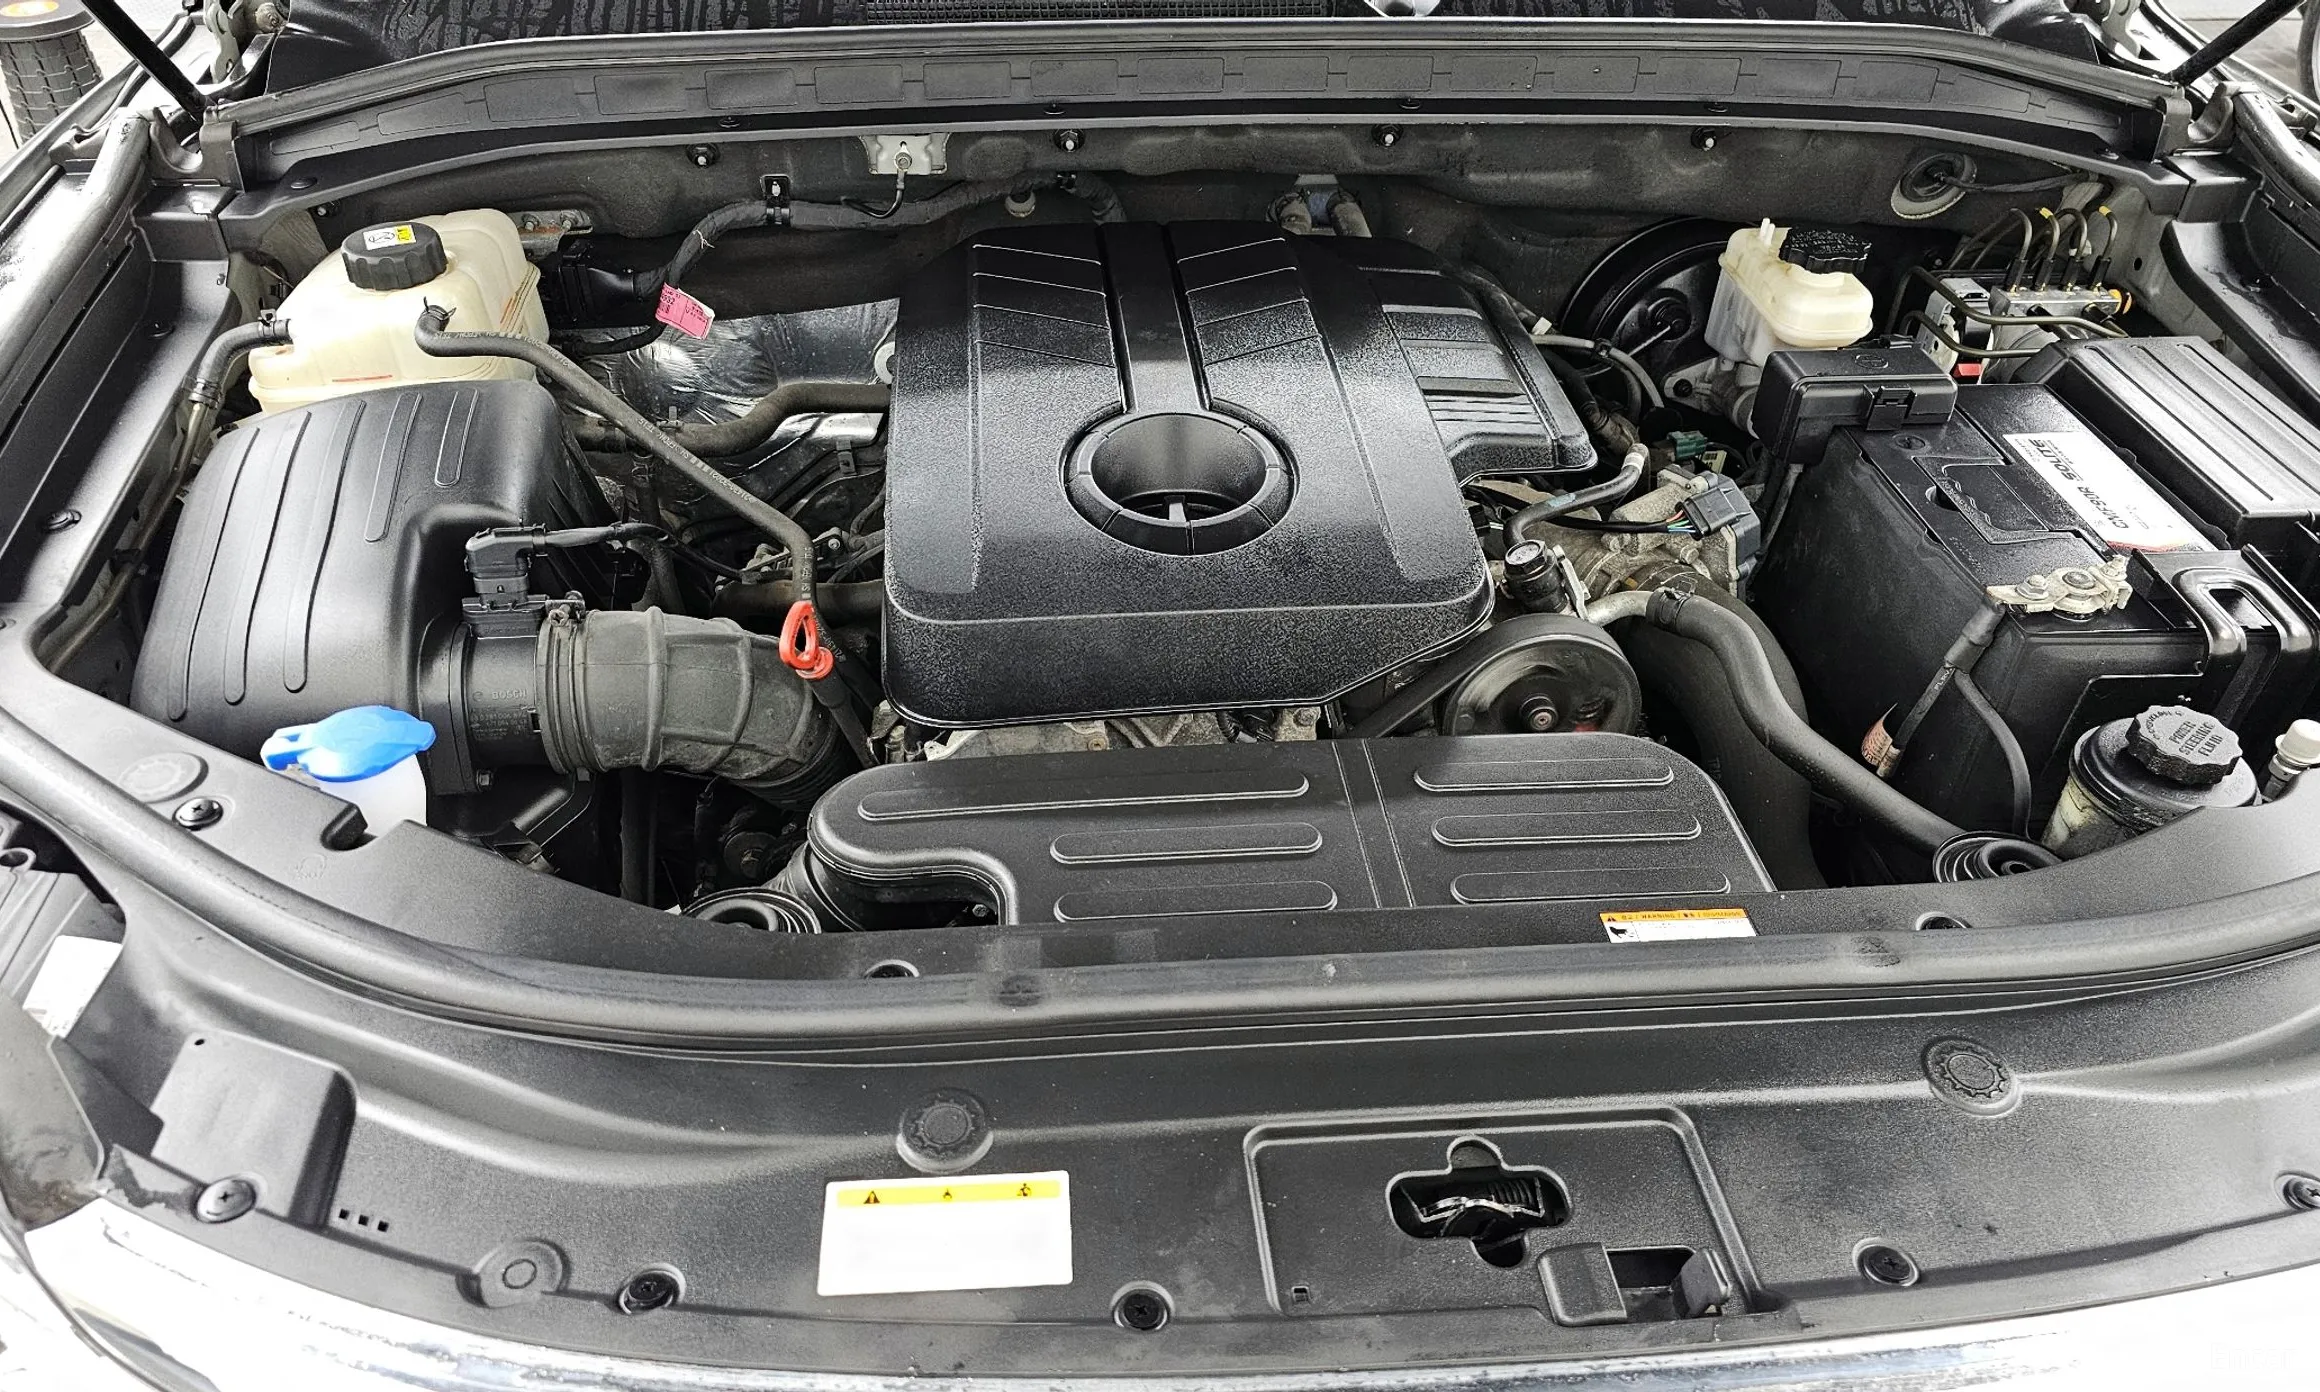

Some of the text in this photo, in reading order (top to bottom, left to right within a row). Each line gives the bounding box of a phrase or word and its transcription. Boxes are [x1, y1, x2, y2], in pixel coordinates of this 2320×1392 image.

[2028, 438, 2078, 481] SOLITE
[2077, 485, 2130, 530] CMF90R
[491, 688, 528, 701] BOSCH
[2168, 720, 2197, 744] POWER
[2179, 720, 2215, 756] STEERING
[2197, 734, 2224, 757] FLUID
